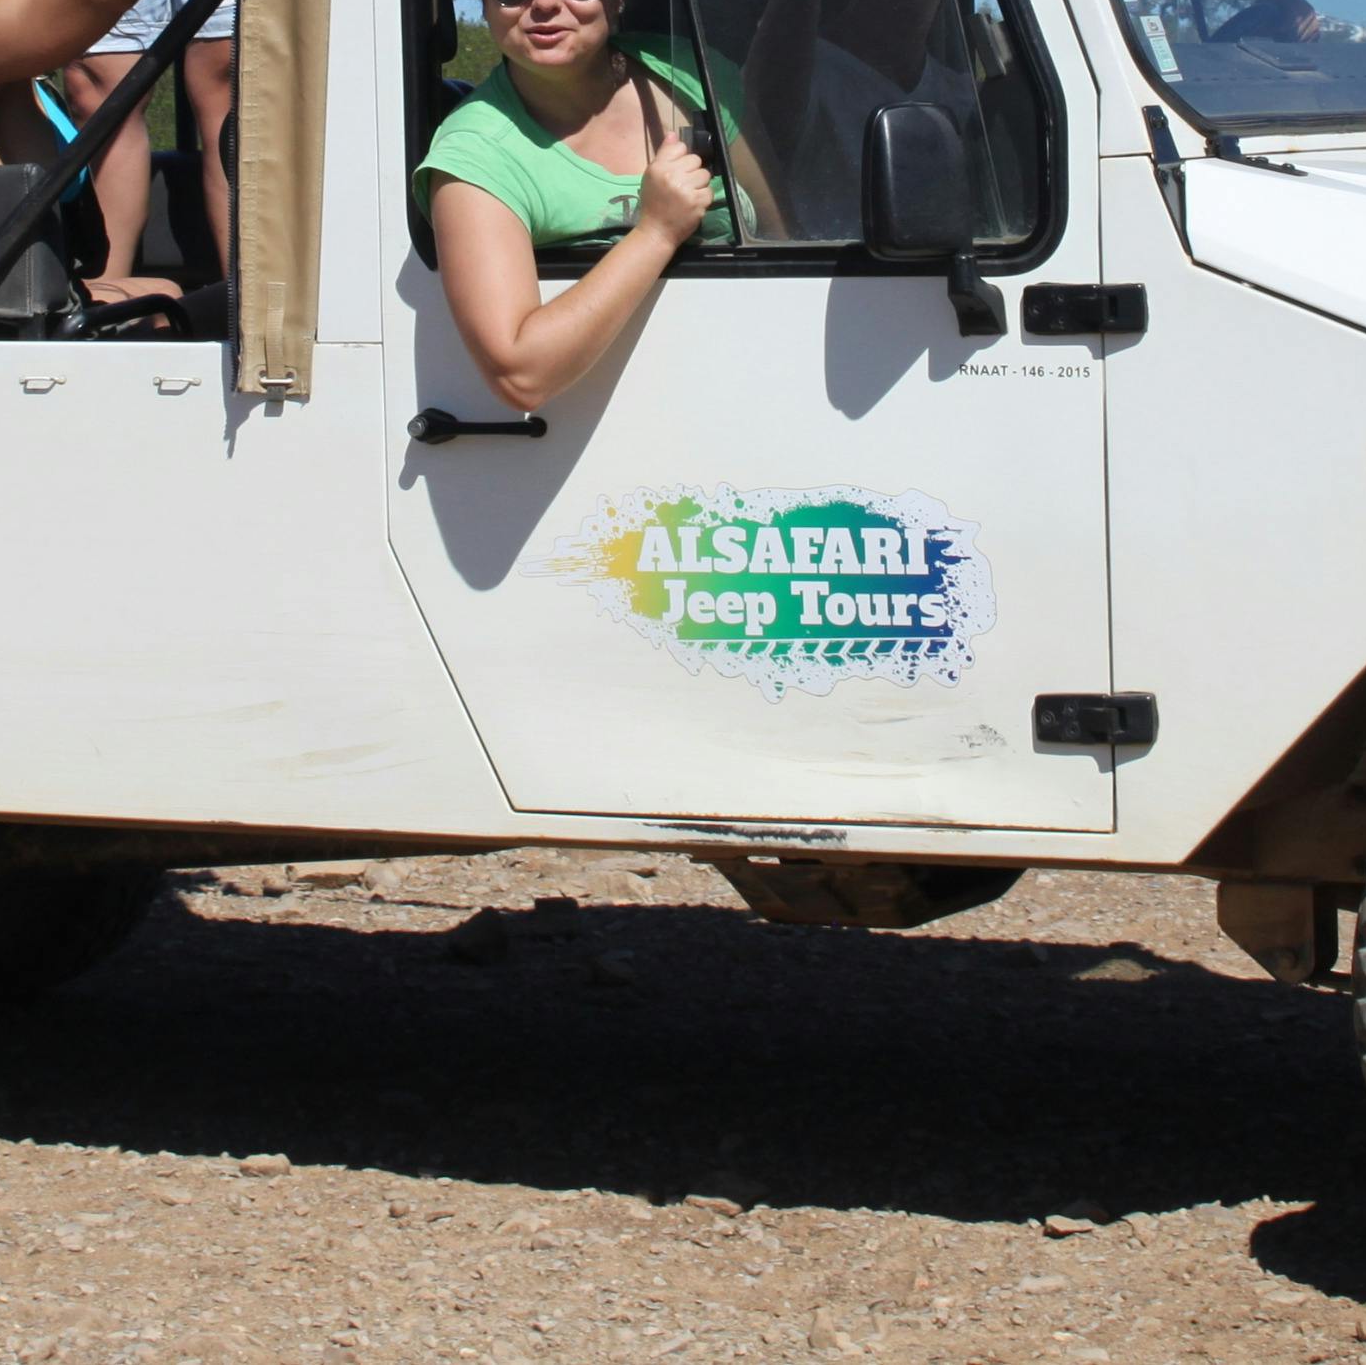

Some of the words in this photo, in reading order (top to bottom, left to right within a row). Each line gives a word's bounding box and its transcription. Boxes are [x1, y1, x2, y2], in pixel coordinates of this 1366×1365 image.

[958, 363, 1009, 376] RNAAT
[1021, 365, 1045, 377] 146
[1057, 366, 1091, 378] 2015
[637, 526, 929, 575] ALSAFARI
[662, 579, 777, 636] Jeep
[790, 580, 947, 627] Tours
